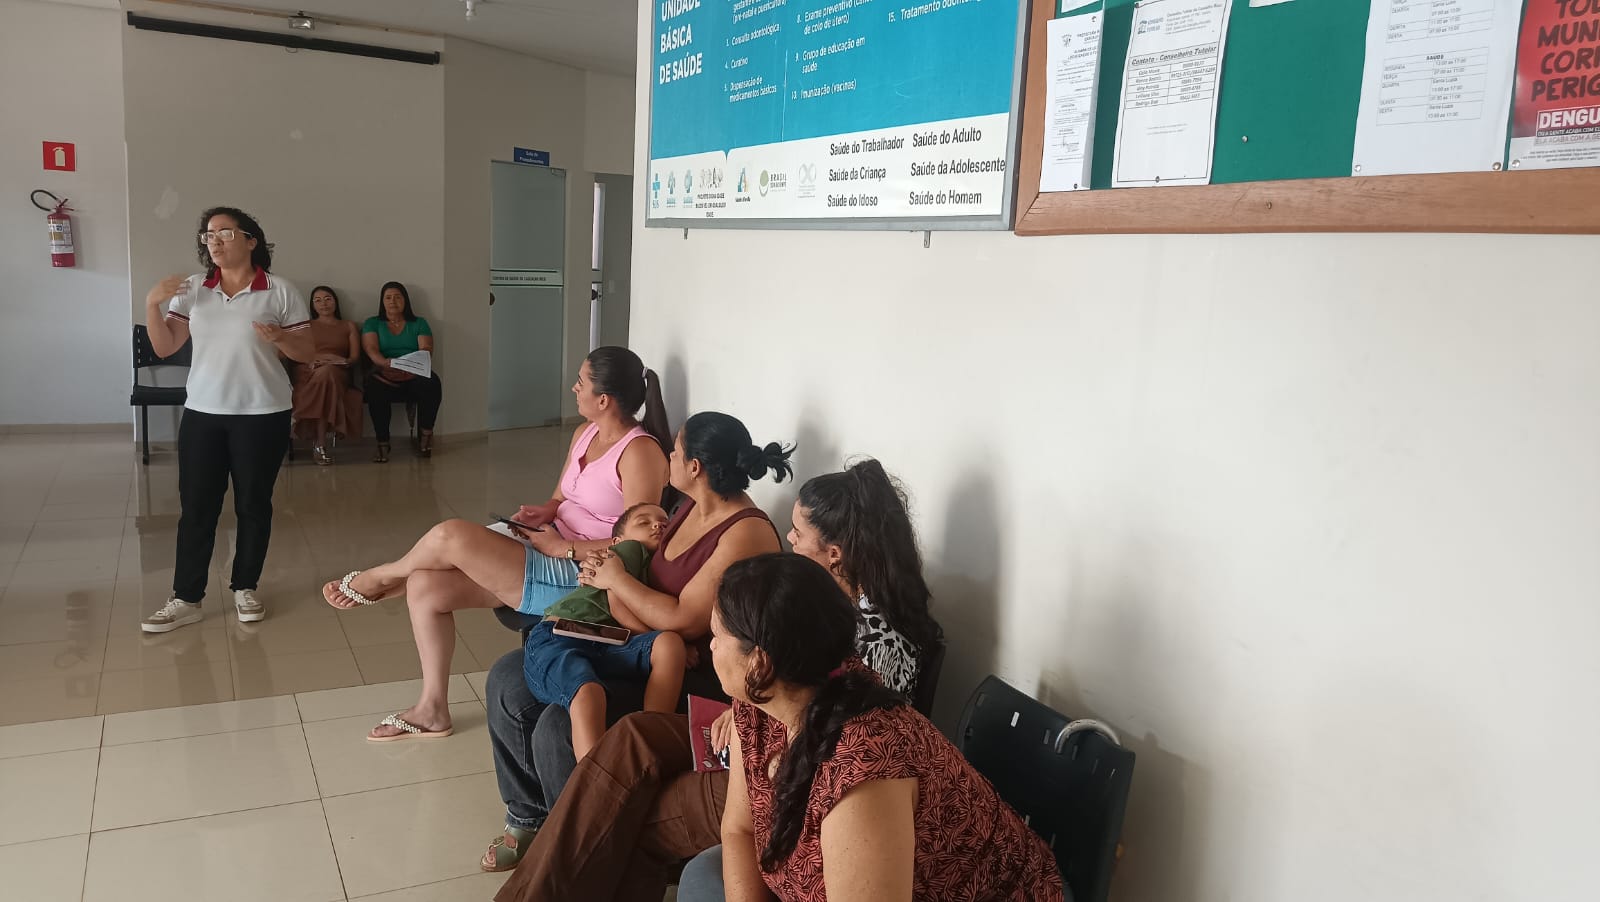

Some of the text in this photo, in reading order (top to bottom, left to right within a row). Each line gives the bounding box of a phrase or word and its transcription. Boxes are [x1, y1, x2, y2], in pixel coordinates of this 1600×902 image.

[804, 9, 822, 22] Exame
[822, 0, 853, 18] preventivo
[900, 1, 940, 21] Tratamento
[732, 33, 750, 46] Consulta
[750, 23, 780, 40] odontológica
[804, 24, 811, 35] de
[824, 18, 832, 30] de
[1537, 19, 1600, 48] MUN
[660, 24, 692, 54] BÁSICA
[802, 48, 818, 62] Grupo
[820, 45, 827, 57] de
[828, 38, 855, 54] educação
[855, 36, 866, 47] em
[730, 56, 749, 69] Curativo
[1132, 56, 1155, 66] Contato
[1193, 46, 1217, 56] Tutelar
[659, 52, 703, 85] DE SAÚDE
[802, 62, 818, 74] saúde
[729, 88, 760, 103] medicamentos
[800, 83, 831, 100] Imunização
[831, 78, 857, 94] (vacinas)
[1531, 74, 1600, 102] PERIG
[1538, 108, 1600, 128] DENGU
[830, 136, 905, 156] Saúde do Trabalhador
[912, 127, 982, 148] Saúde do Adulto
[1548, 136, 1570, 144] ACABA
[1570, 134, 1584, 142] COM
[828, 166, 887, 182] Saúde da Criança
[910, 158, 1006, 177] Saúde da Adolescente
[828, 194, 879, 208] Saúde do Idoso
[909, 190, 982, 206] Saúde do Homem
